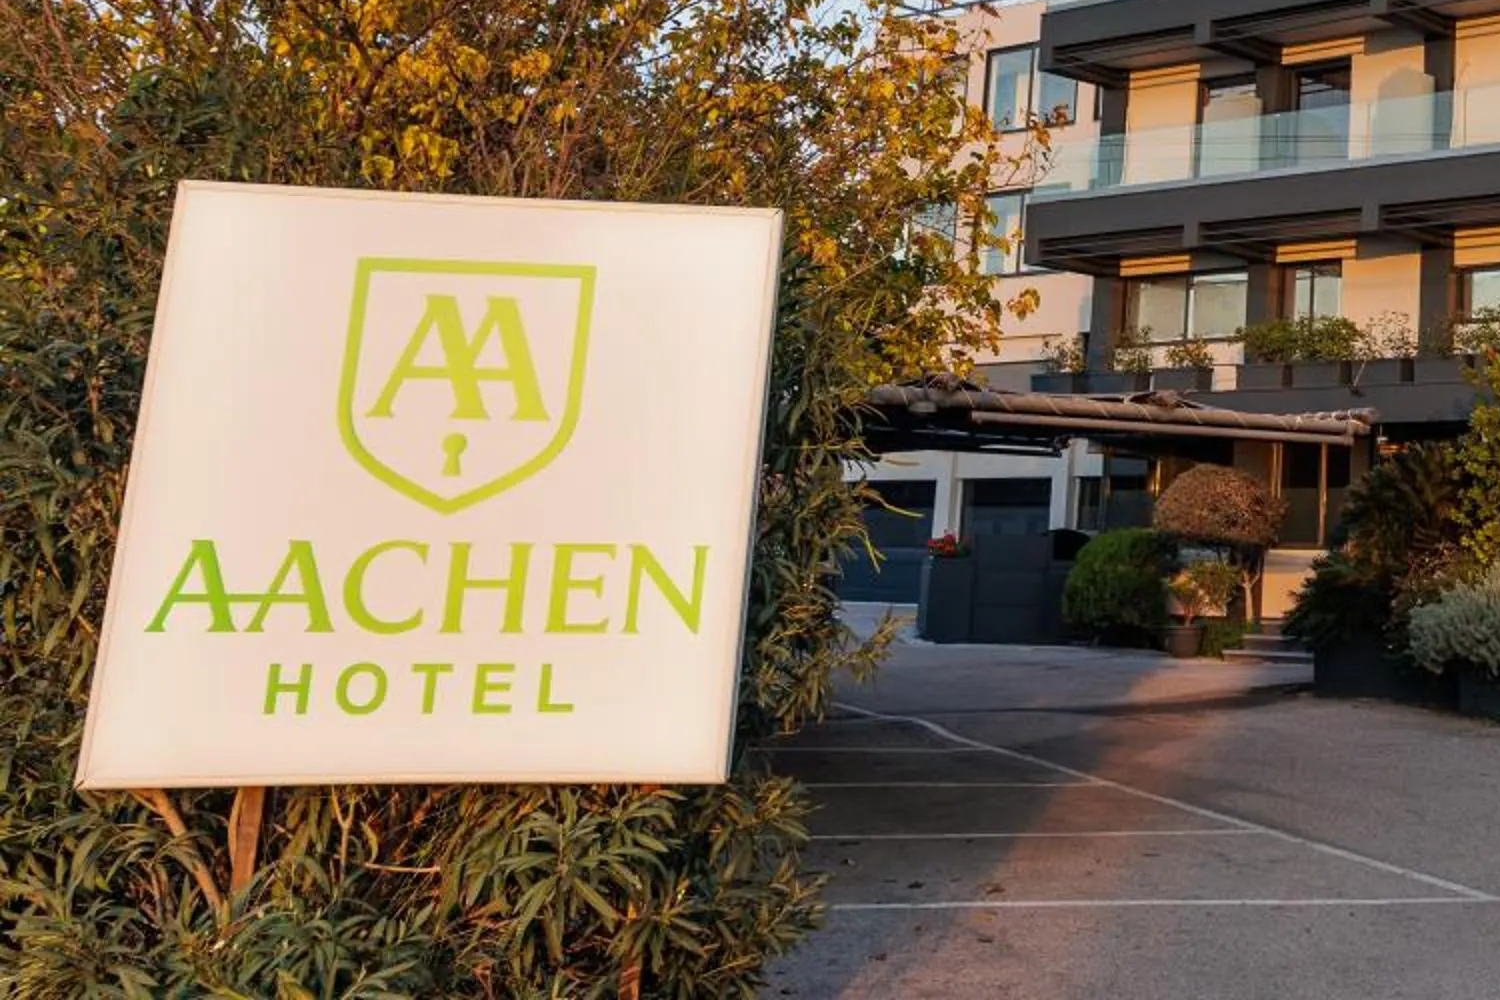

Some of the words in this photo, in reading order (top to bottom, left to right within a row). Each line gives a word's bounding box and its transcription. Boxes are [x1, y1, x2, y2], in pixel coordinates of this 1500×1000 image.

[364, 294, 551, 422] AA
[143, 538, 711, 636] AACHEN
[262, 661, 575, 716] HOTEL
